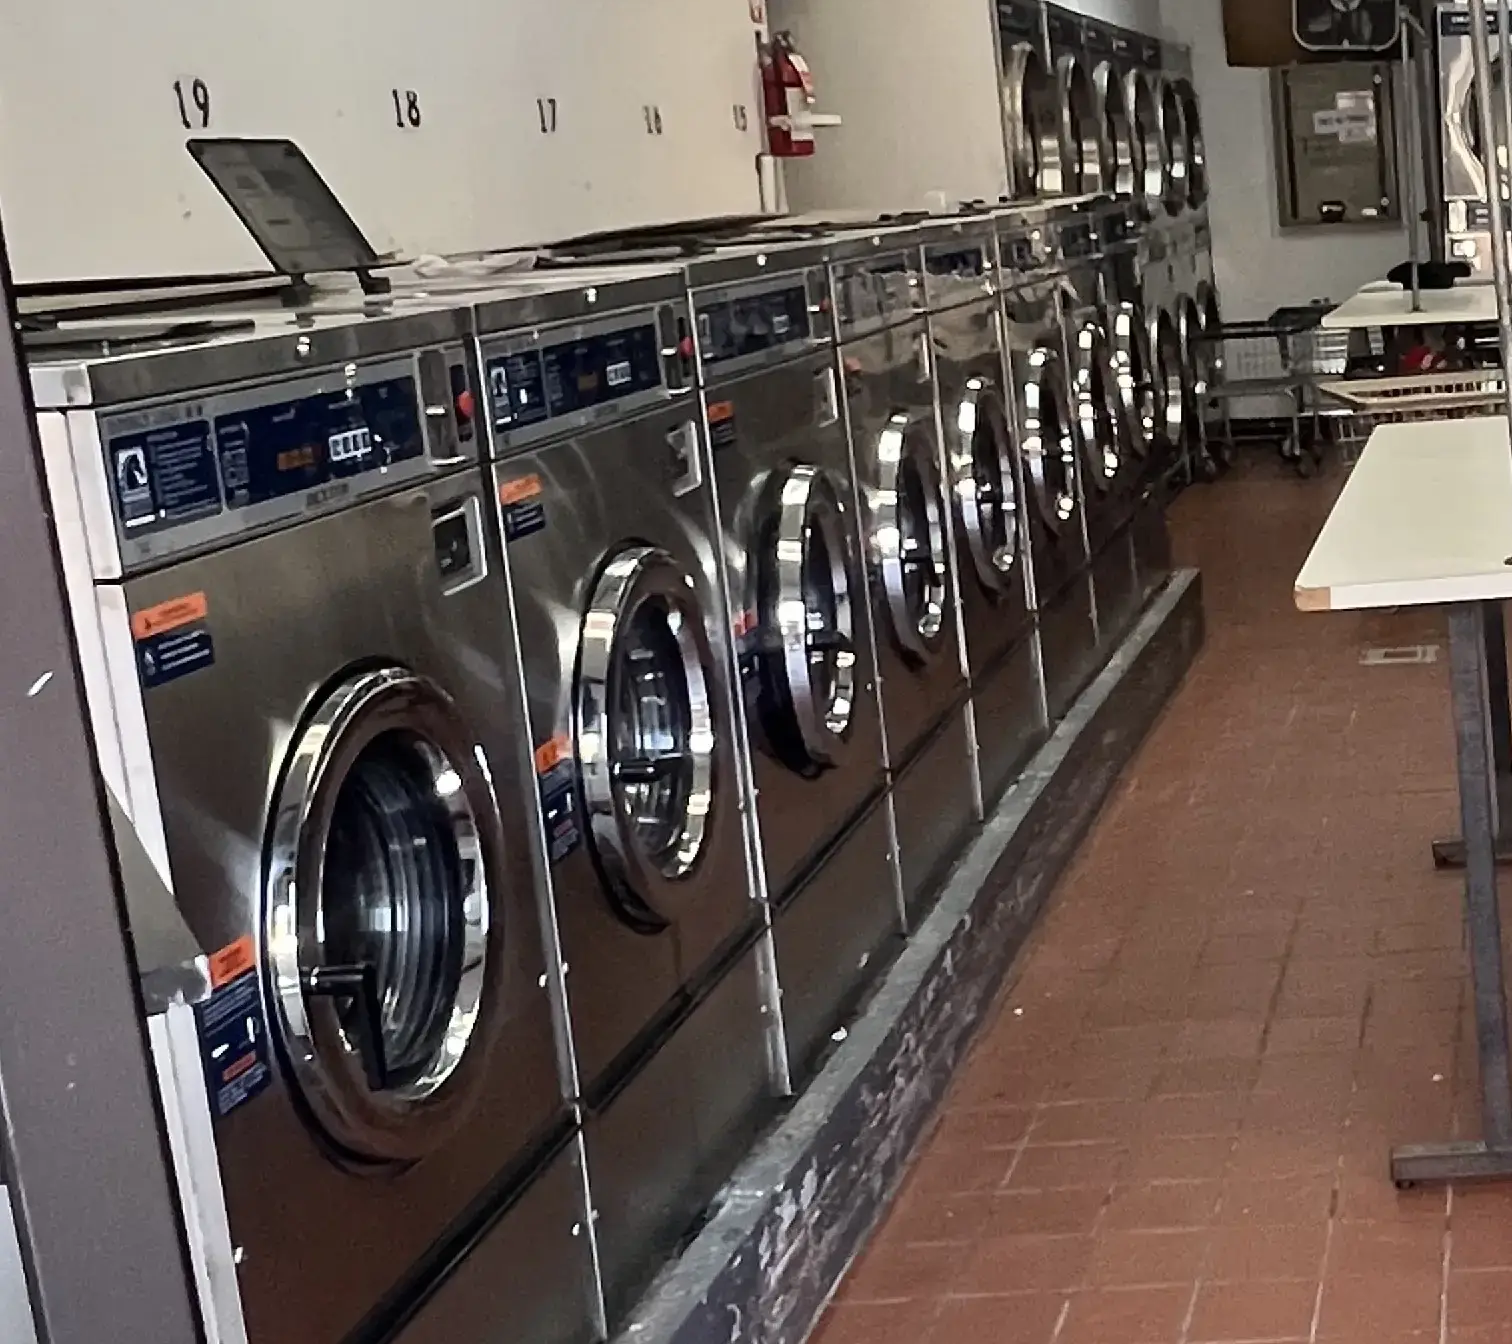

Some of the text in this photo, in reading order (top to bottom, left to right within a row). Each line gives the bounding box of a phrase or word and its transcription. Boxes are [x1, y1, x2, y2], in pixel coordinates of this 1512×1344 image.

[173, 78, 210, 129] 19
[392, 88, 421, 128] 18
[537, 98, 556, 133] 17
